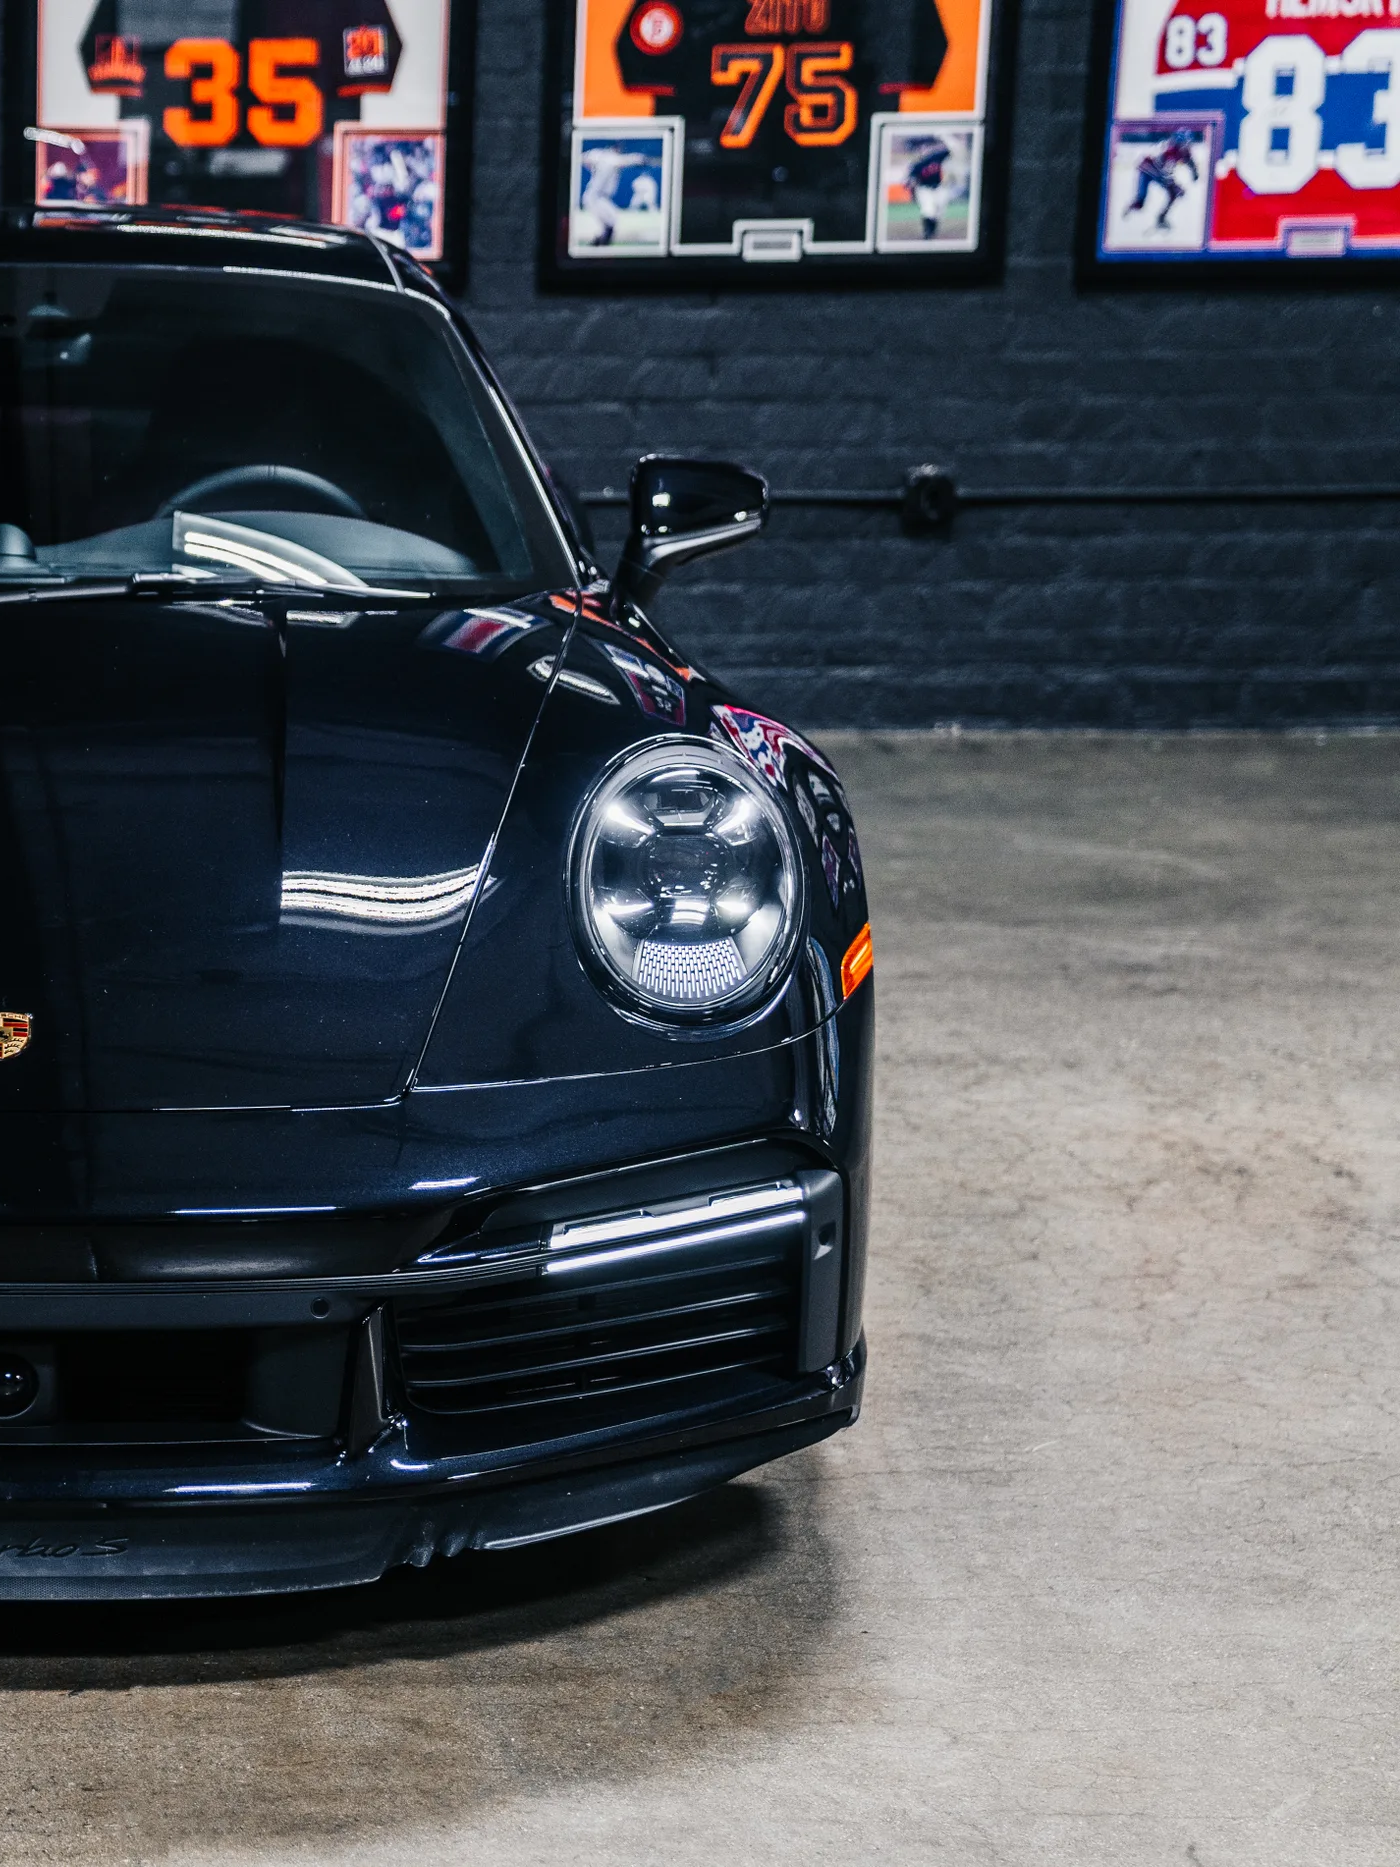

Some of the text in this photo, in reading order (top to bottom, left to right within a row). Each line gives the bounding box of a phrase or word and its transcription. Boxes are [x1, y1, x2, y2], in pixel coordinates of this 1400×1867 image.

[163, 38, 322, 147] 35
[1166, 13, 1227, 68] 83
[711, 42, 857, 148] 75
[1236, 28, 1400, 195] 83
[79, 1538, 129, 1557] S
